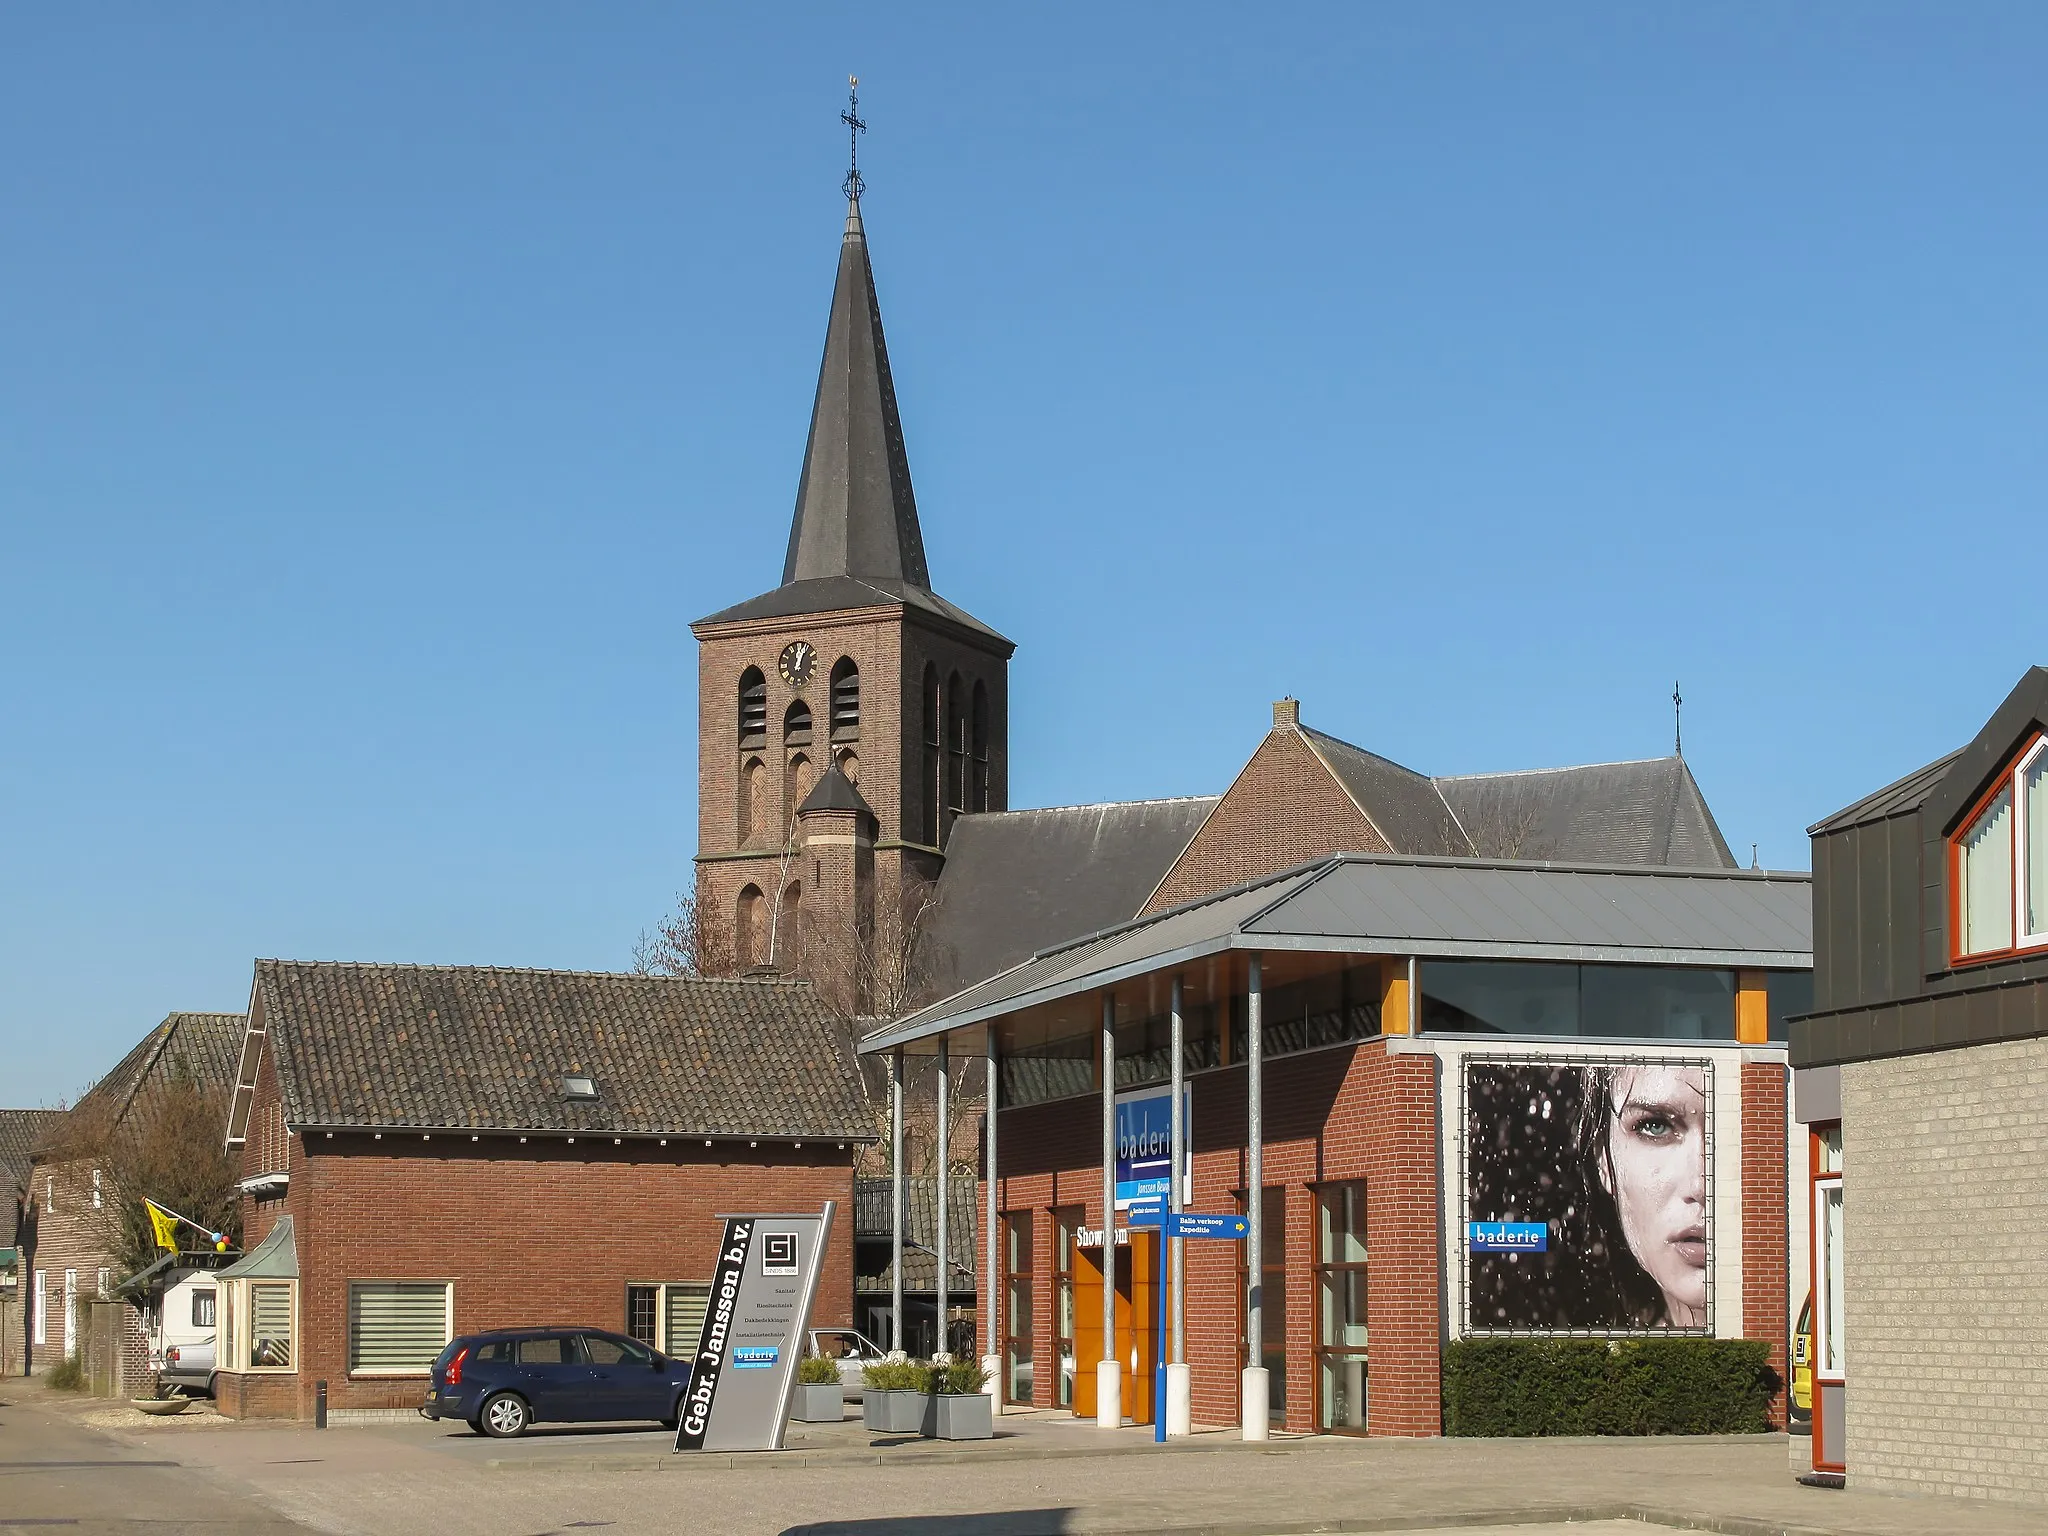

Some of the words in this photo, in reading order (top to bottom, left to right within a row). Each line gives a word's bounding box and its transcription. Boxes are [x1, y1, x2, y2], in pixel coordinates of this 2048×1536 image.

[1120, 1110, 1170, 1159] baderi
[1197, 1218, 1224, 1226] verkoop
[1179, 1226, 1210, 1234] Expeditie
[1476, 1225, 1539, 1243] baderie
[684, 1373, 716, 1435] Gebr.
[701, 1270, 739, 1366] Janssen
[723, 1222, 750, 1264] b.v.
[737, 1348, 775, 1359] baderie
